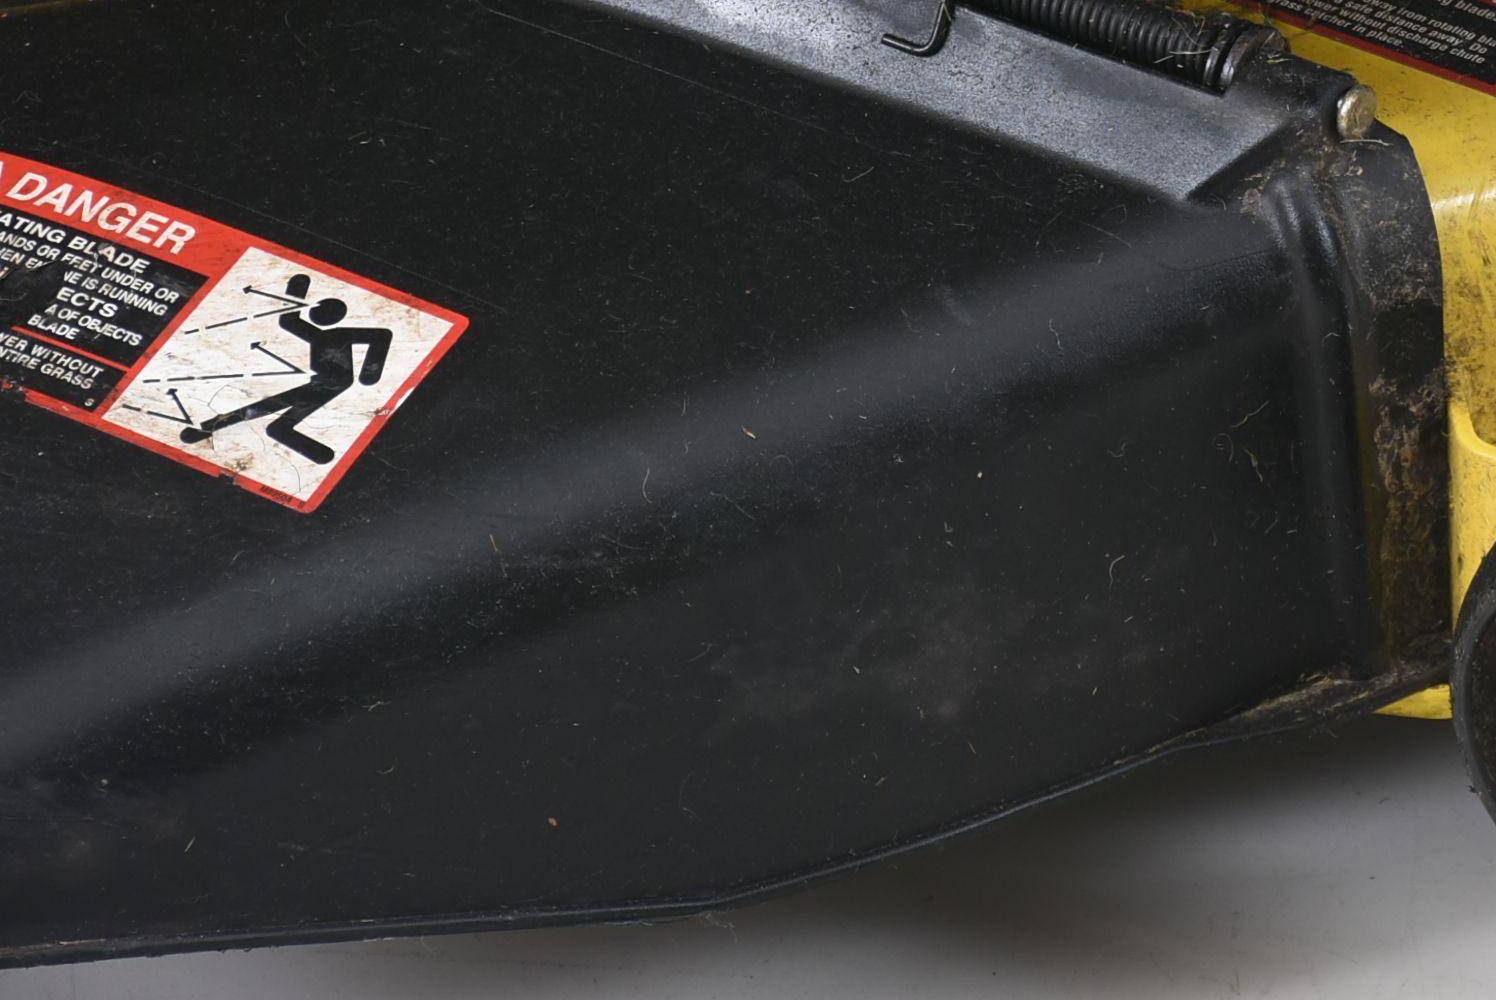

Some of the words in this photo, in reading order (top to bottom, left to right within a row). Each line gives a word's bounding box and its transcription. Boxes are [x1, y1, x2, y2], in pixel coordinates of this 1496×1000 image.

[1340, 6, 1385, 30] without
[1386, 25, 1448, 52] discharge
[1449, 46, 1486, 64] chute
[1344, 0, 1373, 14] safe
[1374, 7, 1428, 33] distance
[1469, 42, 1488, 54] Do
[1351, 22, 1366, 34] in
[1367, 29, 1404, 49] place.
[1396, 6, 1427, 22] from
[1428, 18, 1476, 41] rotating
[6, 171, 196, 255] DANGER
[0, 209, 66, 244] ATING
[67, 236, 150, 274] BLADE
[36, 245, 61, 260] OR
[101, 266, 154, 295] UNDER
[154, 287, 179, 304] OR
[81, 276, 99, 291] IS
[98, 282, 169, 317] RUNNING
[27, 314, 80, 341] BLADE
[57, 307, 79, 321] OF
[78, 315, 143, 347] OBJECTS
[31, 343, 104, 378] WITHOUT
[40, 362, 95, 390] GRASS
